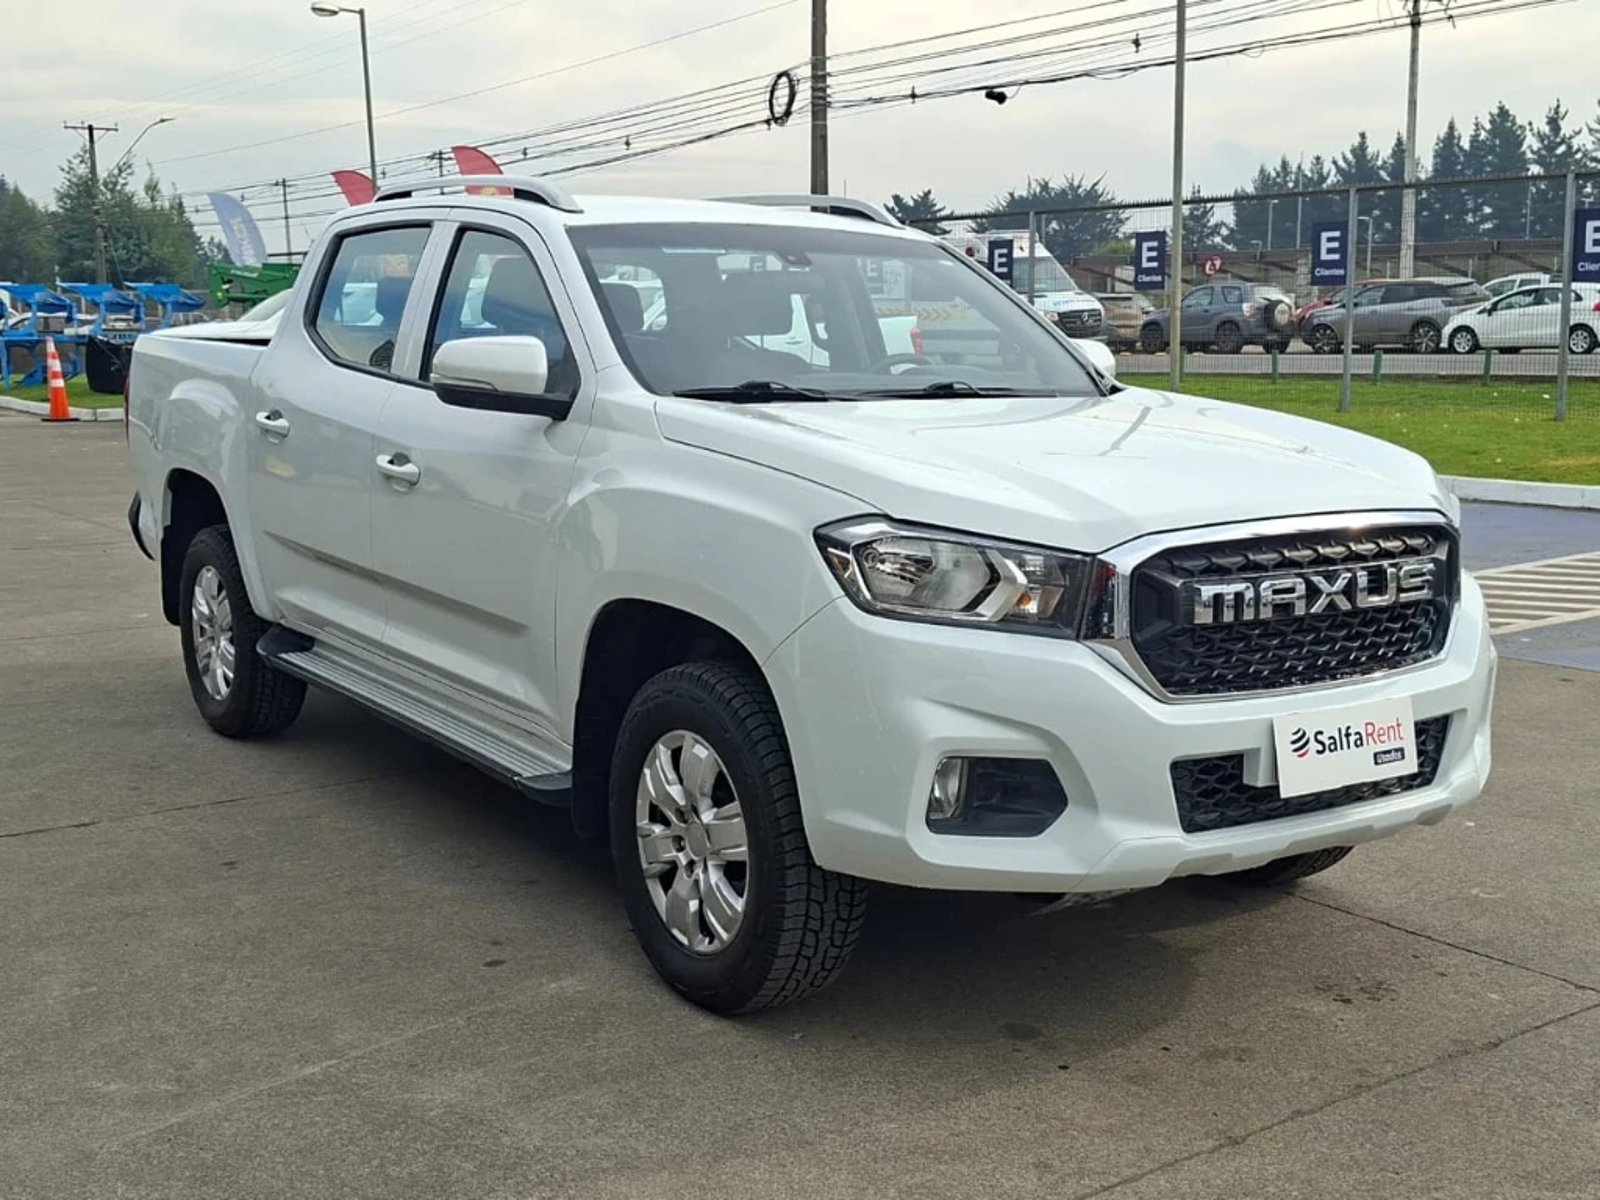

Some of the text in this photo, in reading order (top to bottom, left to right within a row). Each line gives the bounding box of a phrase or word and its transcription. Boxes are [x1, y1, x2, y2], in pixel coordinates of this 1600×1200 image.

[1320, 230, 1341, 260] E
[1585, 220, 1600, 253] E
[993, 248, 1008, 273] E
[1141, 241, 1159, 268] E
[1314, 267, 1345, 277] Clientes
[1193, 562, 1436, 624] MAXUS
[1313, 717, 1404, 756] SalfaRent
